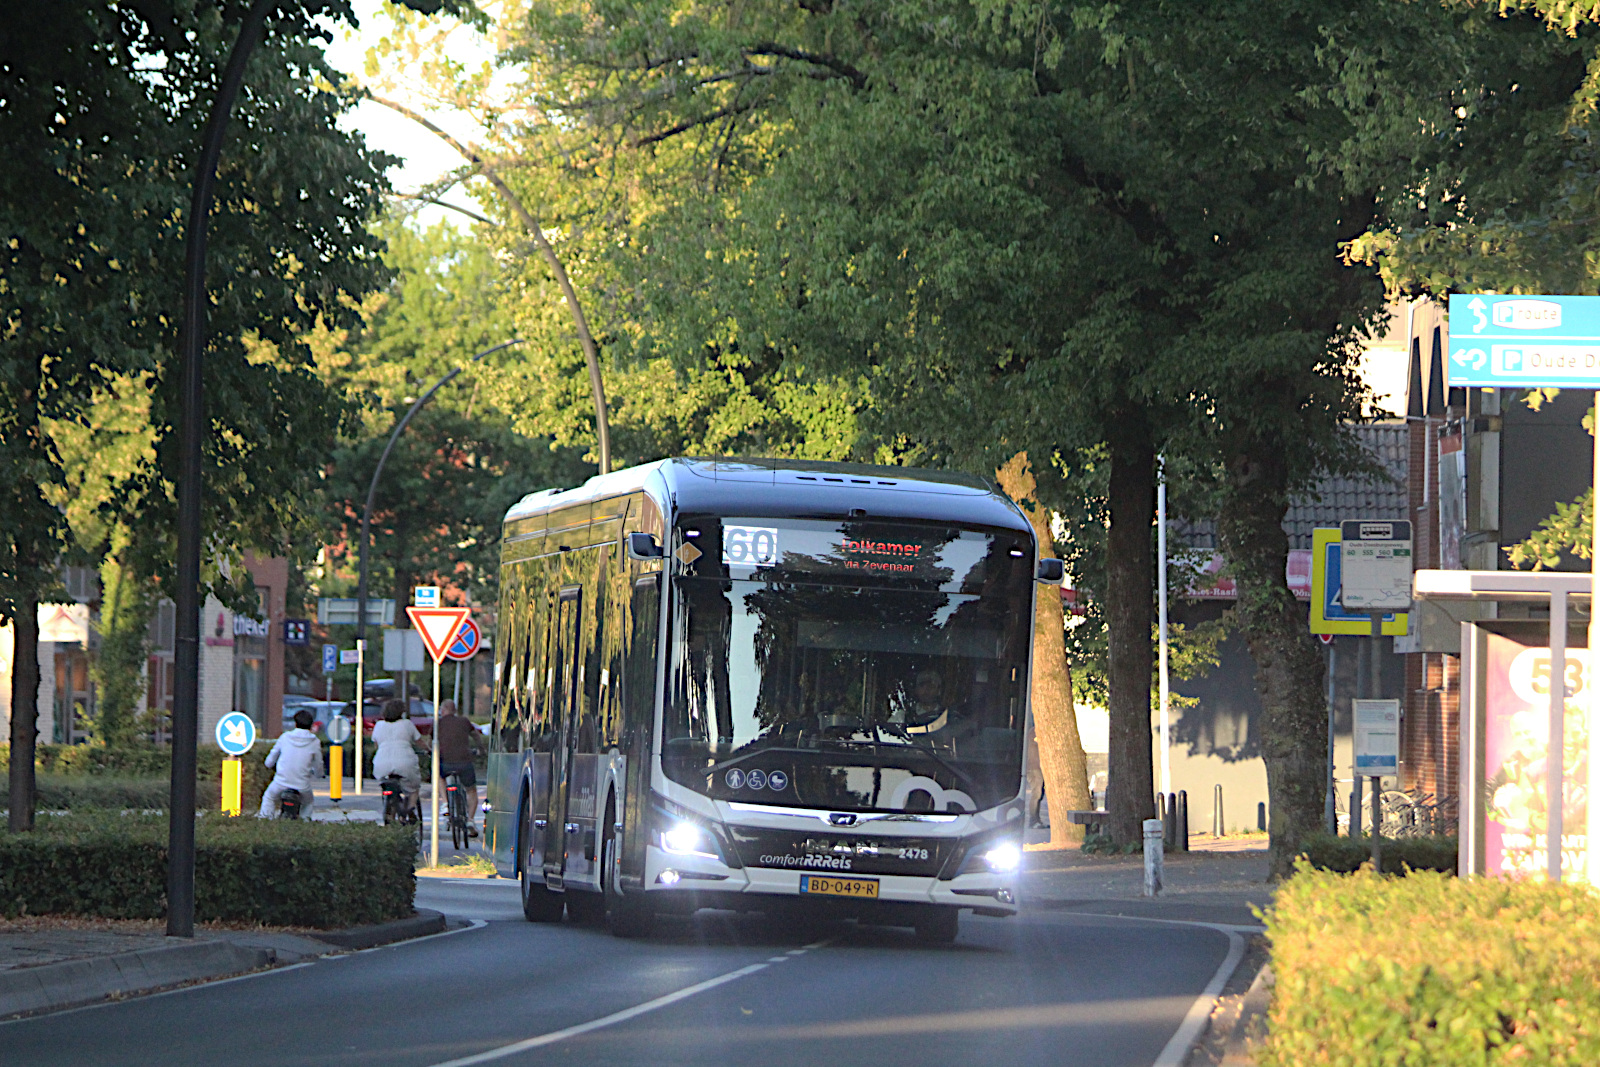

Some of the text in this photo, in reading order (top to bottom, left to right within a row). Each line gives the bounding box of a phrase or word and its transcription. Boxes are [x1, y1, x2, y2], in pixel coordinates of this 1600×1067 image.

[1518, 309, 1557, 320] route
[1531, 353, 1577, 368] Oude
[1585, 353, 1600, 368] D
[726, 528, 774, 563] 60
[841, 538, 922, 557] Tolkamer
[843, 559, 915, 572] via Zevenaar
[1292, 588, 1311, 597] Dön
[1531, 657, 1592, 695] 53
[760, 854, 852, 869] comfortRRReis
[899, 848, 928, 860] 2478
[811, 880, 874, 895] BD-049-R
